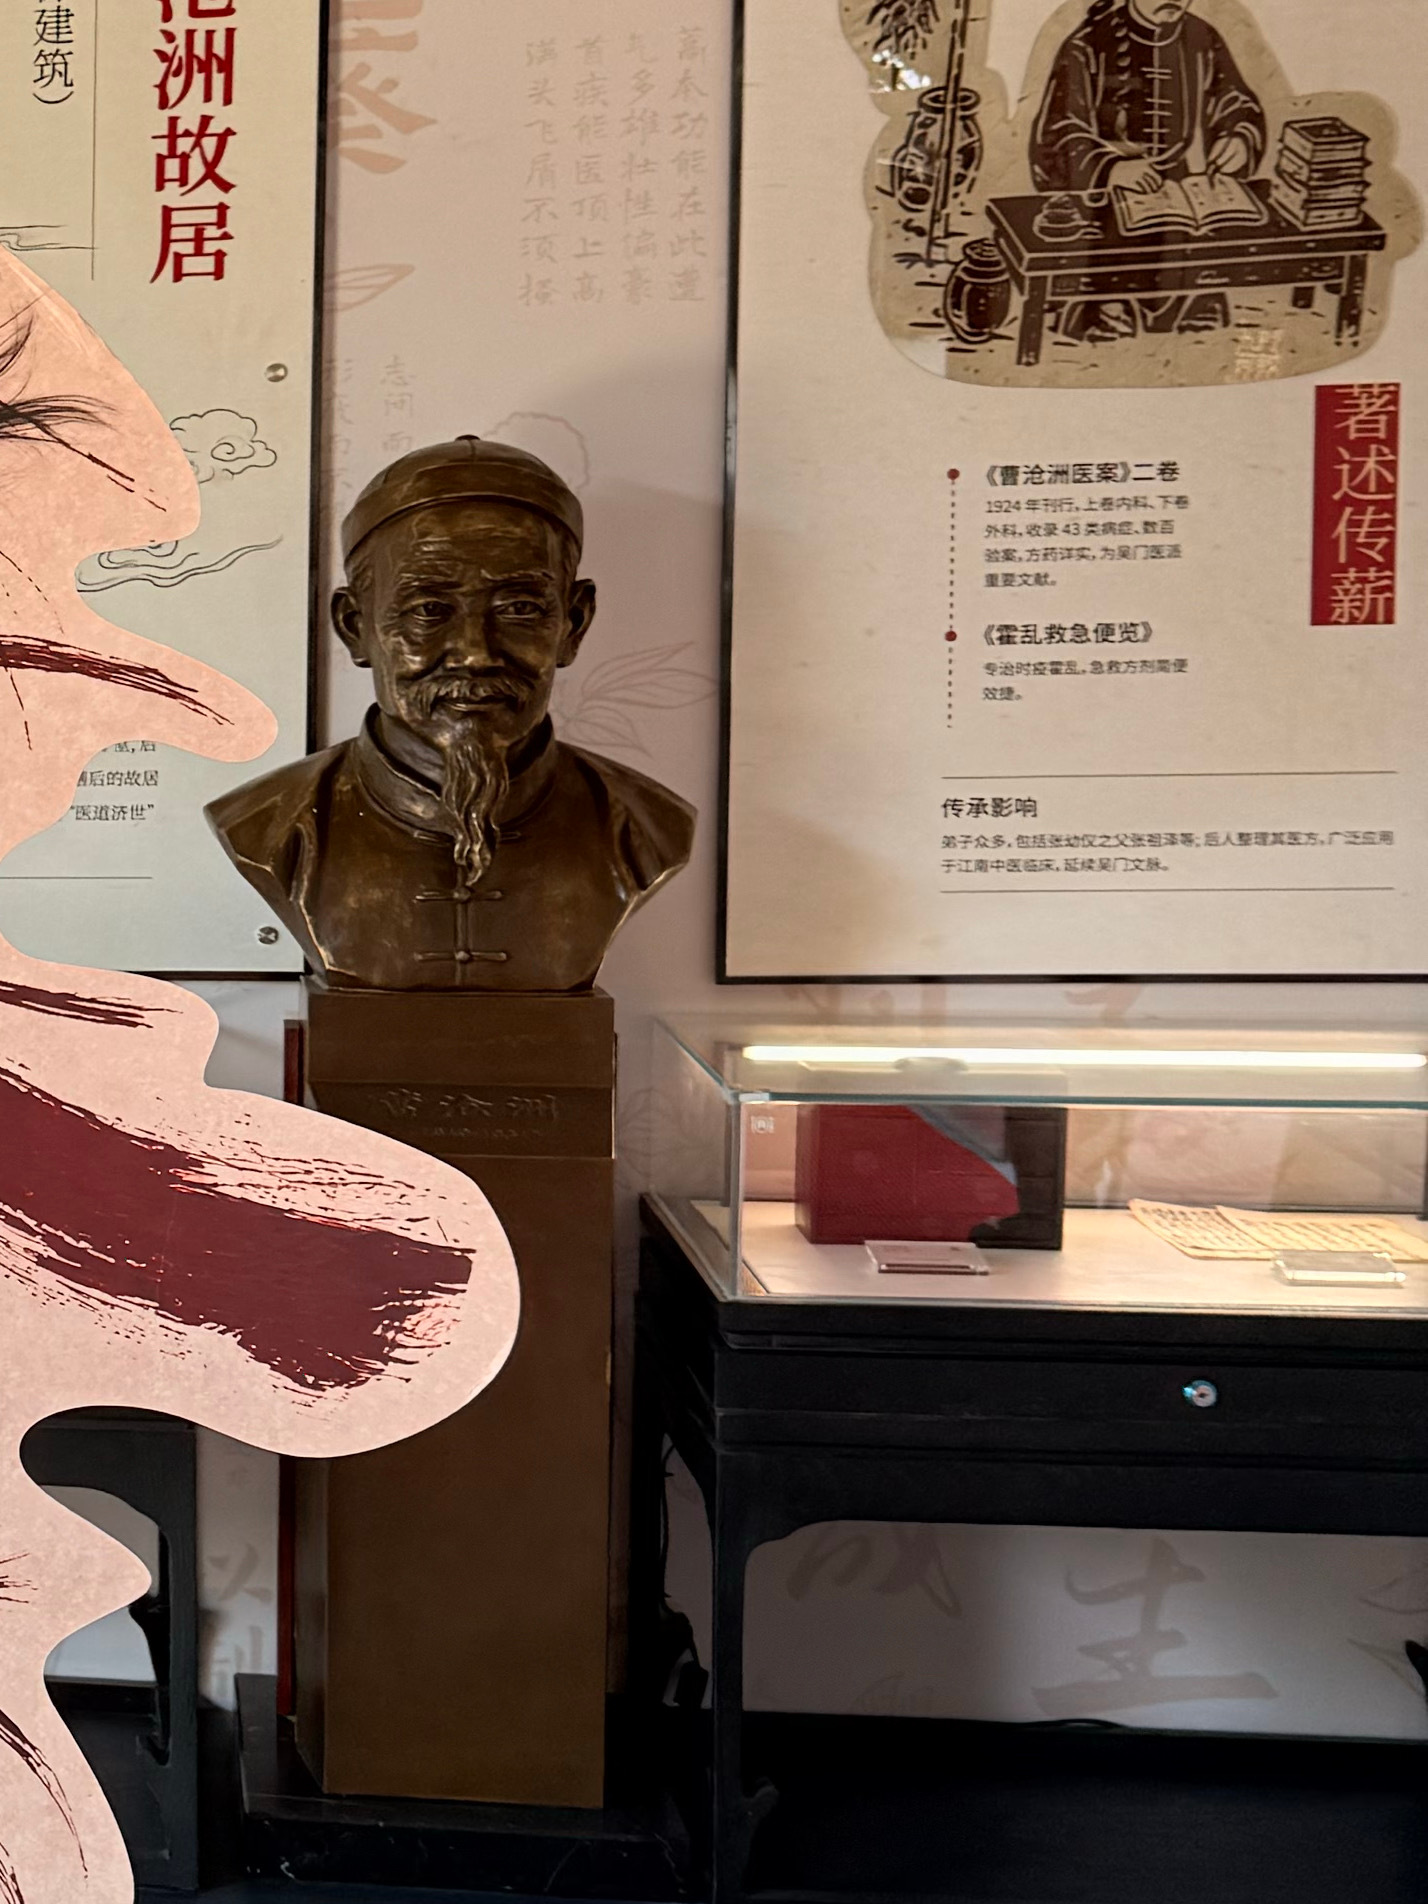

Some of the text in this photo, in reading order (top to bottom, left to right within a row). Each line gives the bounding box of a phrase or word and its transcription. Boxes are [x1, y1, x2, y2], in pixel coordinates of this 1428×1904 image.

[986, 461, 1180, 486] 《曹沧洲医案》二卷
[1331, 384, 1397, 623] 著述传薪
[983, 621, 1153, 646] 《霍乱救急便览》
[942, 797, 1038, 818] 传承影响
